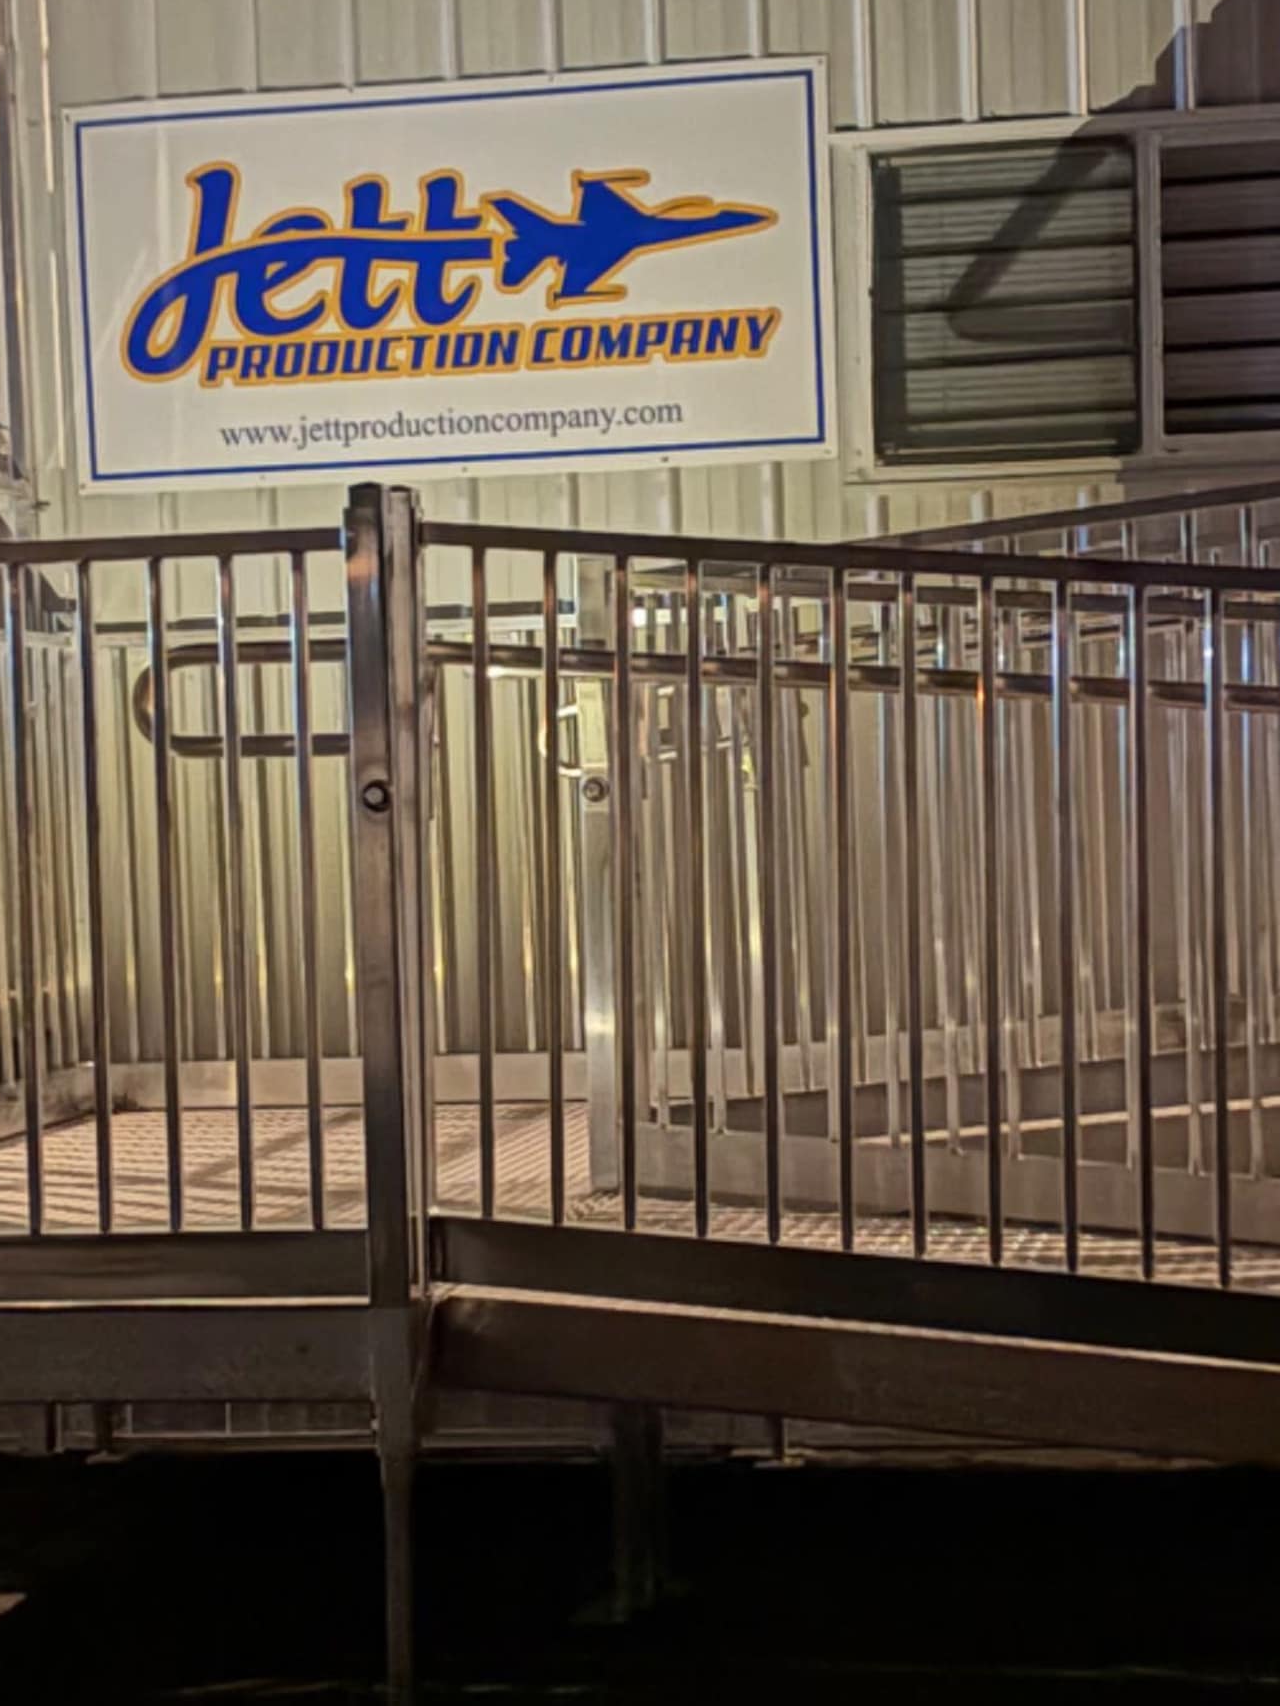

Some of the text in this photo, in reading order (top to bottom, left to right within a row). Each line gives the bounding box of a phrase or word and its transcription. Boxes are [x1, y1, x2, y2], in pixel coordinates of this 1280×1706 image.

[122, 161, 496, 381] Jett
[201, 309, 780, 386] PRODUCTION COMPANY
[219, 401, 684, 450] www.jettproductioncompany.com
